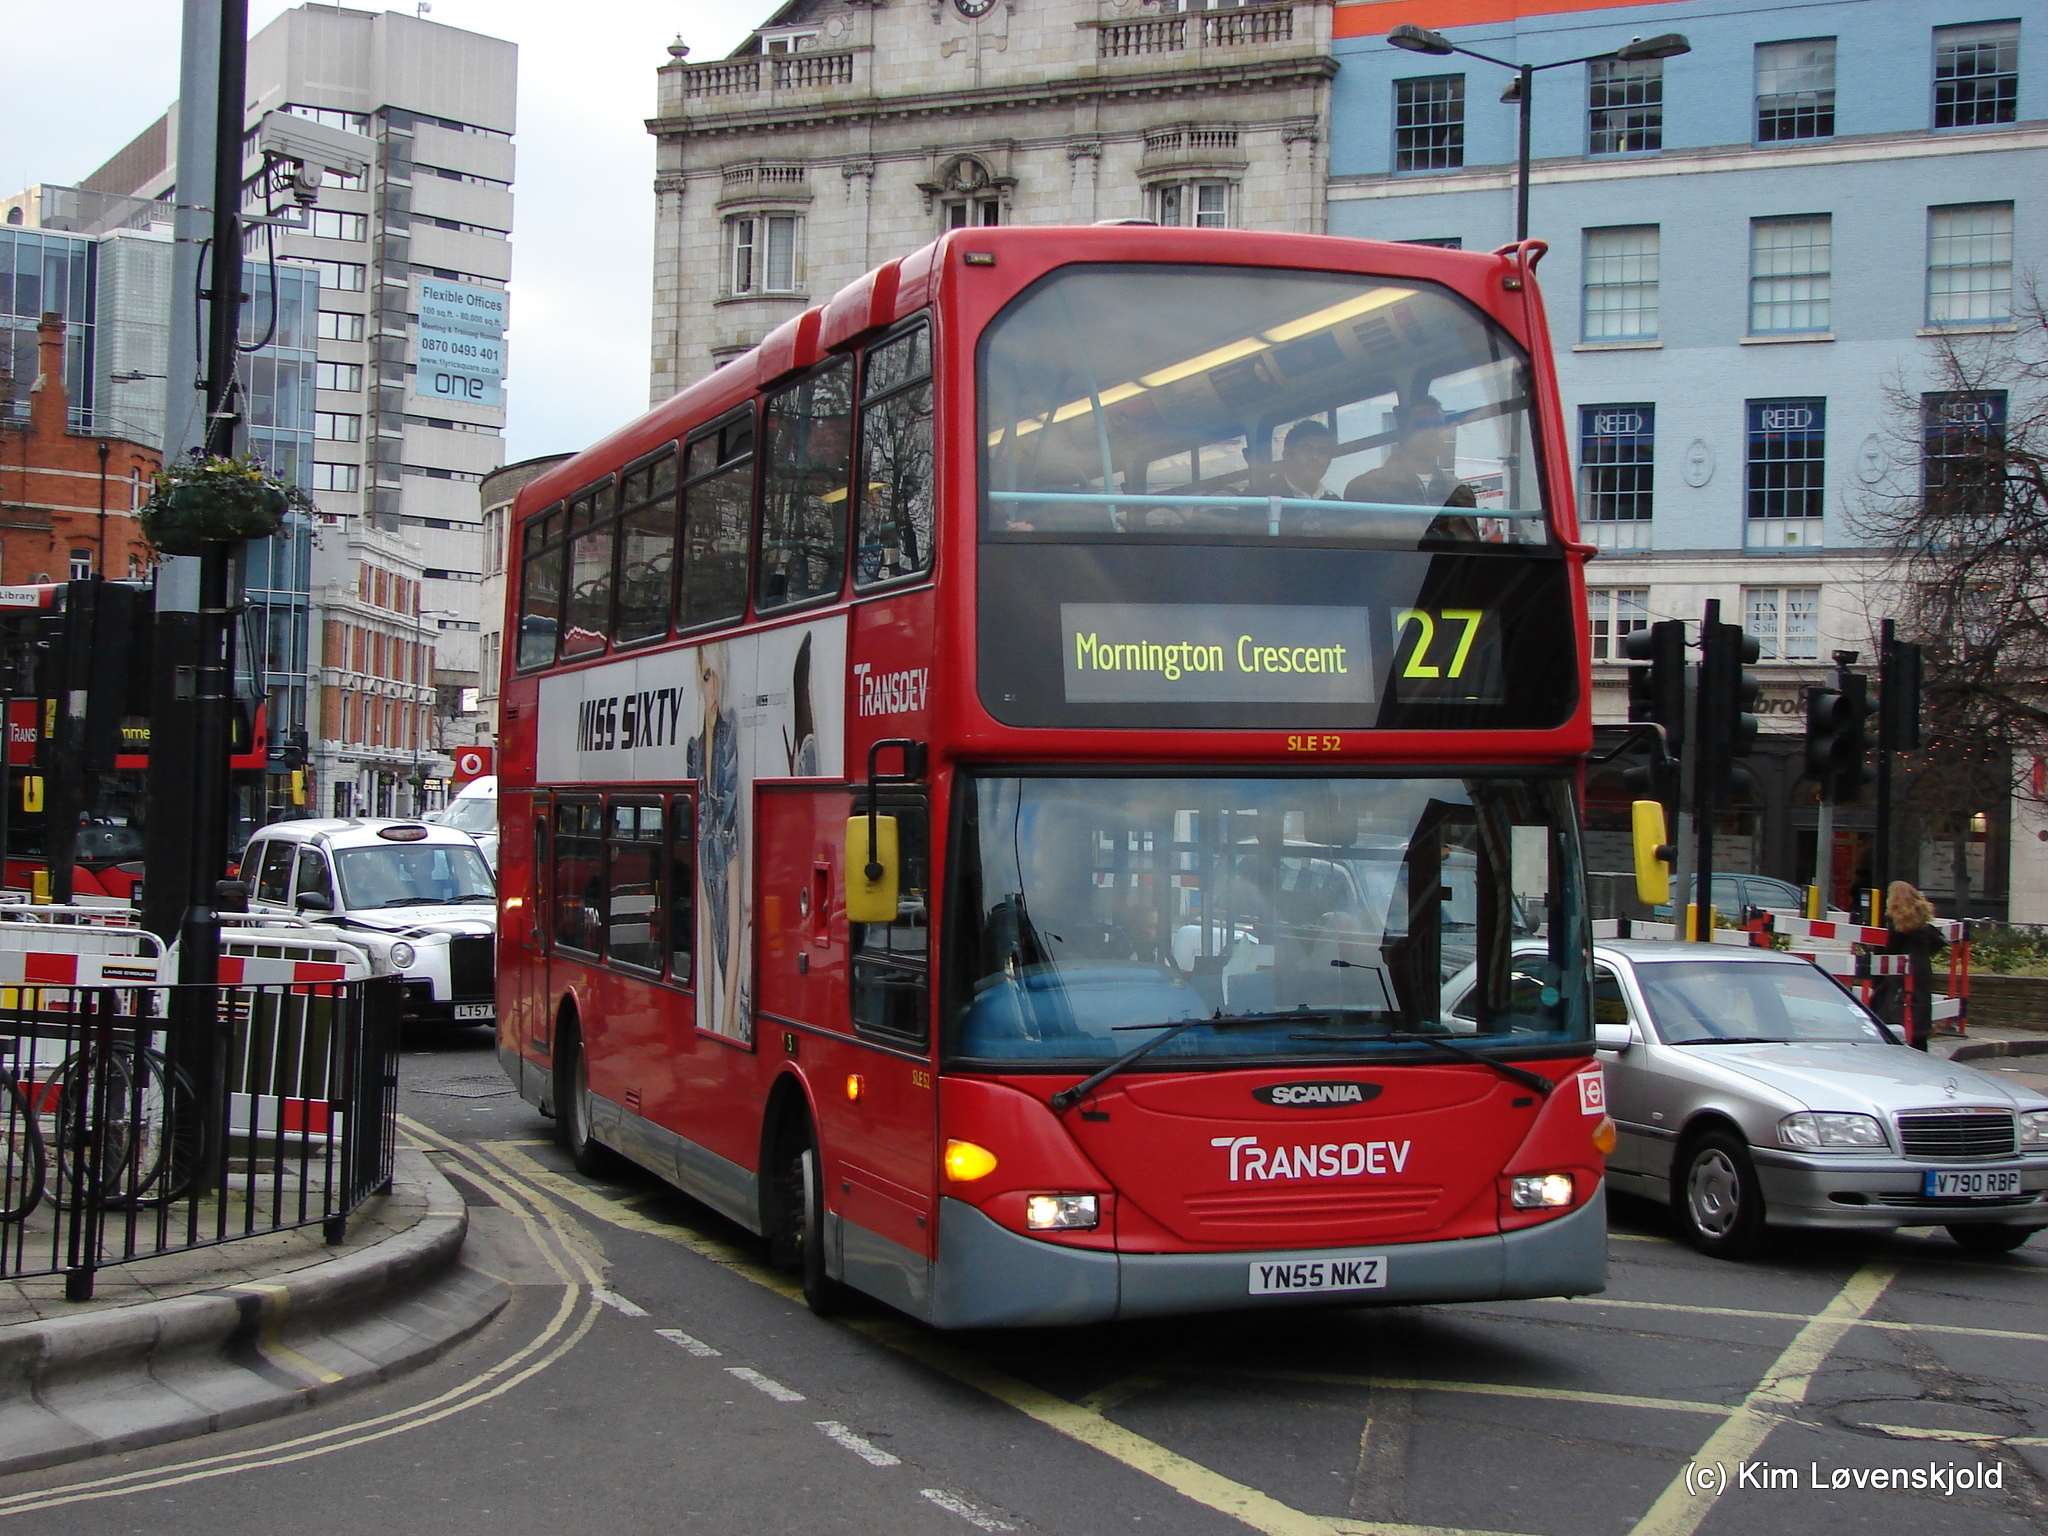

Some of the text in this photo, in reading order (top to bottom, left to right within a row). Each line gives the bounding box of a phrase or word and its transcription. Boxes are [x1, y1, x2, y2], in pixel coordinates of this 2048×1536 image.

[423, 286, 502, 312] Flexible Offices
[422, 306, 435, 315] 100
[421, 322, 446, 333] Meeting
[454, 327, 479, 339] Training
[422, 338, 499, 361] 0870 0493 401
[435, 373, 484, 399] one
[1593, 414, 1643, 434] REED
[1761, 408, 1812, 429] REED
[0, 591, 36, 602] Library
[1396, 608, 1484, 679] 27
[1075, 632, 1348, 681] Mornington Crescent
[576, 686, 684, 752] MISS SIXTY
[1287, 735, 1342, 752] SLE 52
[459, 1005, 489, 1017] LT57
[1271, 1084, 1363, 1104] SCANIA
[1937, 1174, 1982, 1193] V790
[1259, 1260, 1379, 1289] YN55 NKZ
